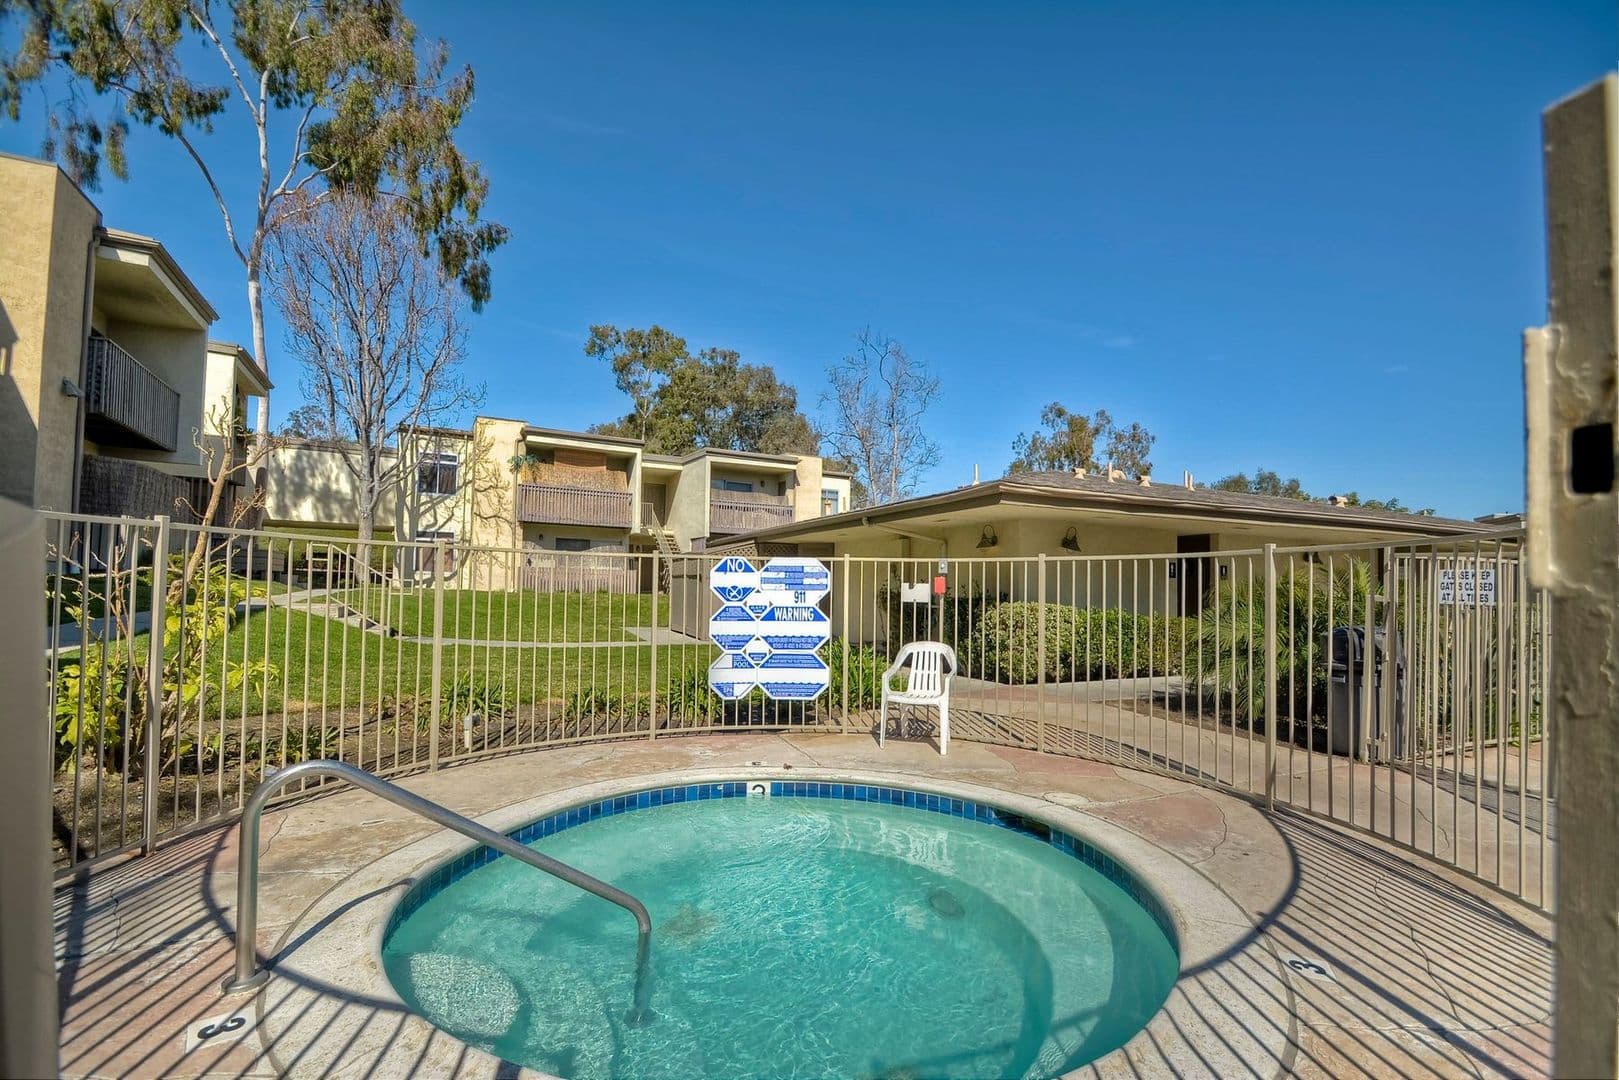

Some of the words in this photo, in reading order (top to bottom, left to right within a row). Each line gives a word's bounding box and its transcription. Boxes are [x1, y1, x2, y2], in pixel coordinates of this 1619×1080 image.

[727, 559, 745, 572] NO
[1443, 571, 1470, 580] PLESE
[1472, 571, 1491, 580] KEP
[1440, 582, 1463, 591] GATS
[1464, 582, 1493, 592] CLSED
[794, 591, 806, 603] 911
[1441, 593, 1450, 601] AT
[1466, 593, 1489, 603] TIES
[774, 607, 815, 621] WARNING
[1288, 959, 1327, 975] 3
[197, 1017, 246, 1040] 3
